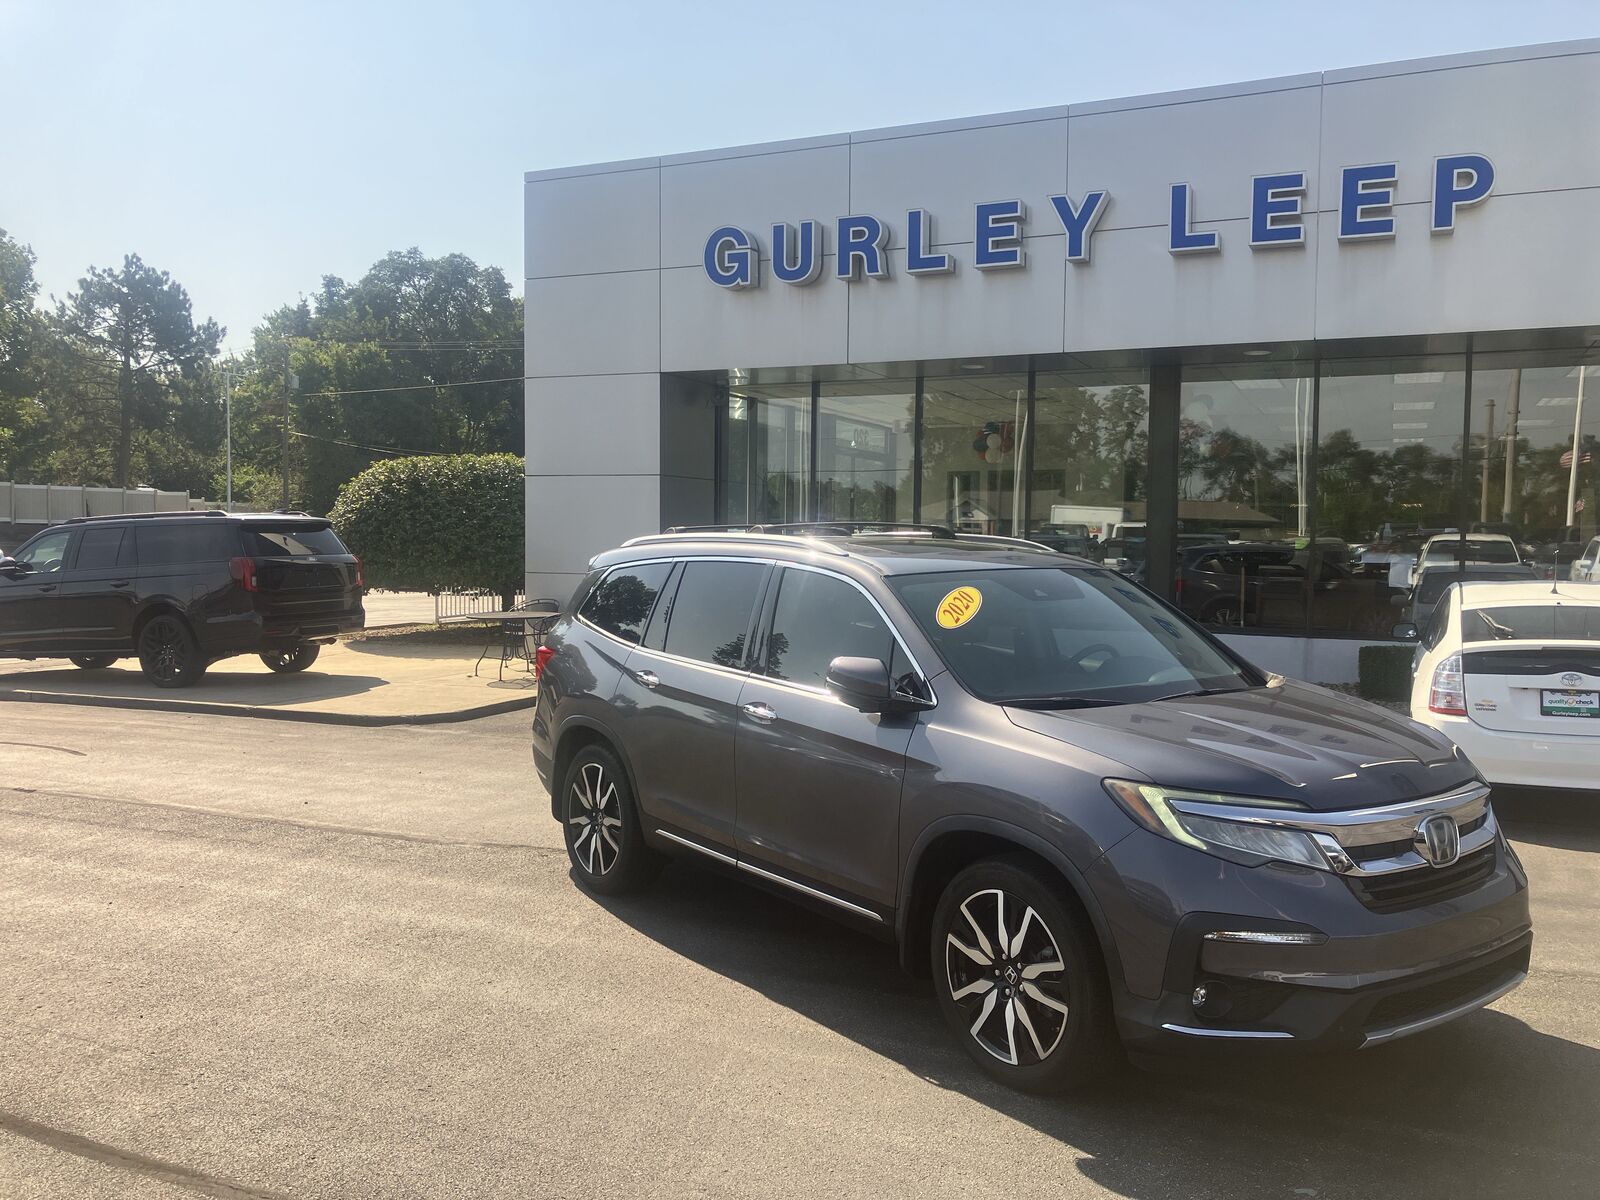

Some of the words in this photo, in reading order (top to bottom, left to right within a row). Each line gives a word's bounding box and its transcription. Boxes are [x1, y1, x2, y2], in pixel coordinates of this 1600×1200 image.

[703, 190, 1111, 291] GURLEY
[1168, 153, 1496, 256] LEEP
[943, 590, 974, 624] 2020
